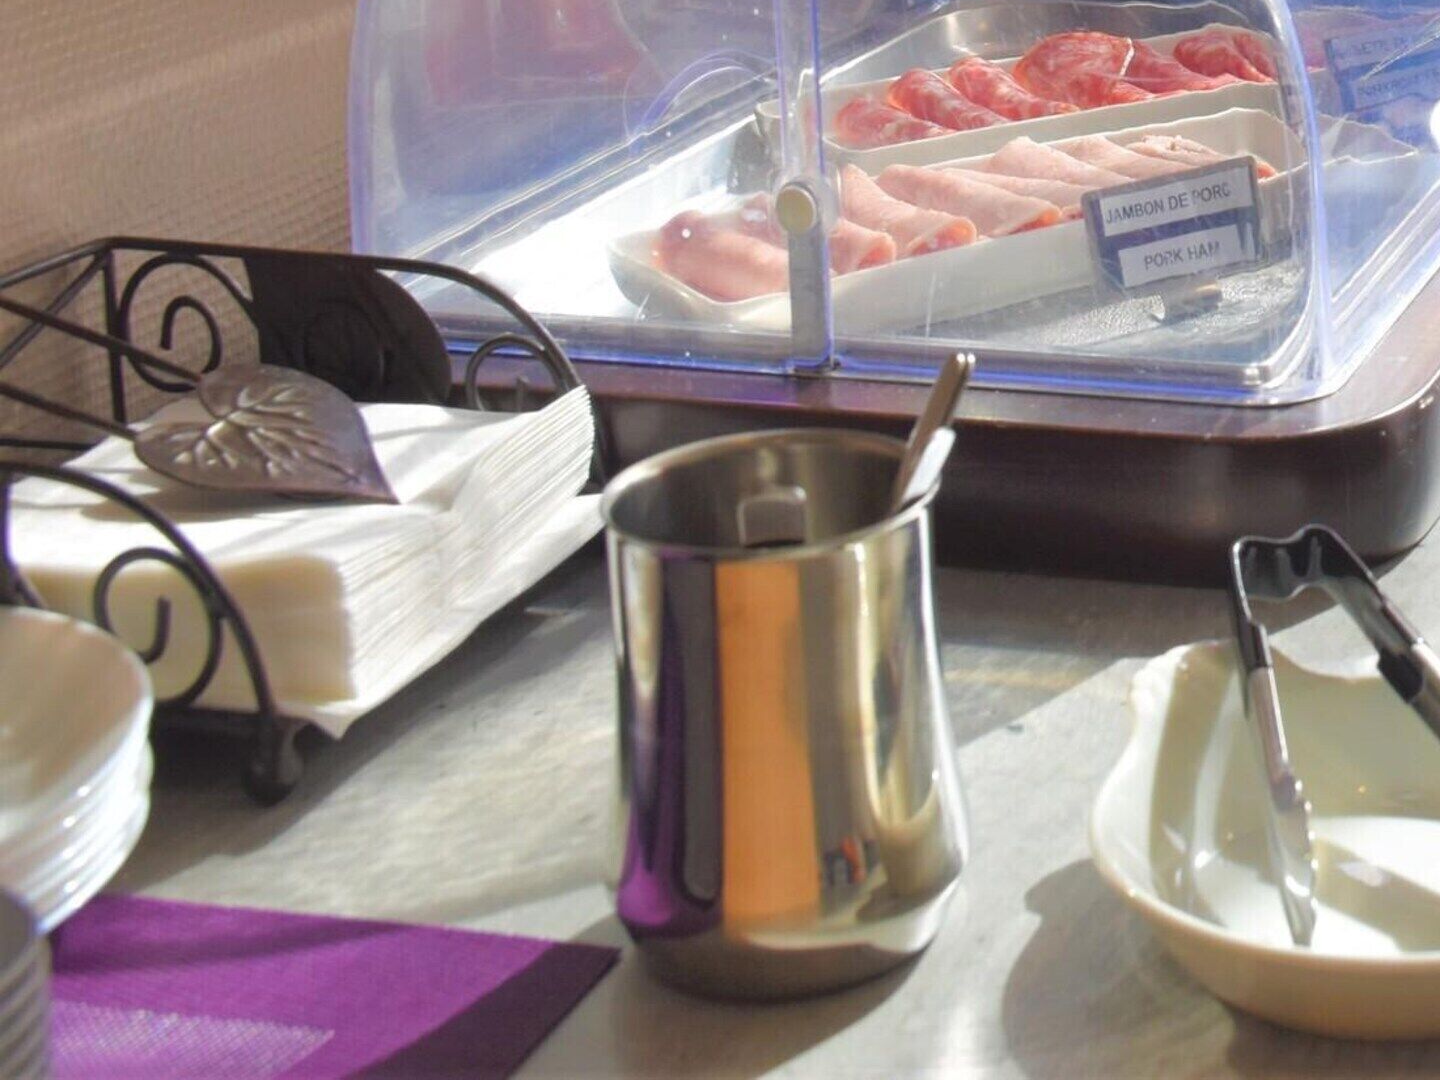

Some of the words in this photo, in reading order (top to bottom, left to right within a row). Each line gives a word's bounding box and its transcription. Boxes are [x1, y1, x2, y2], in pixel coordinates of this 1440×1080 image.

[1105, 200, 1165, 224] JAMBON
[1168, 193, 1189, 209] DE
[1191, 182, 1232, 204] PORC
[1144, 249, 1184, 270] PORK
[1187, 241, 1221, 261] HAM
